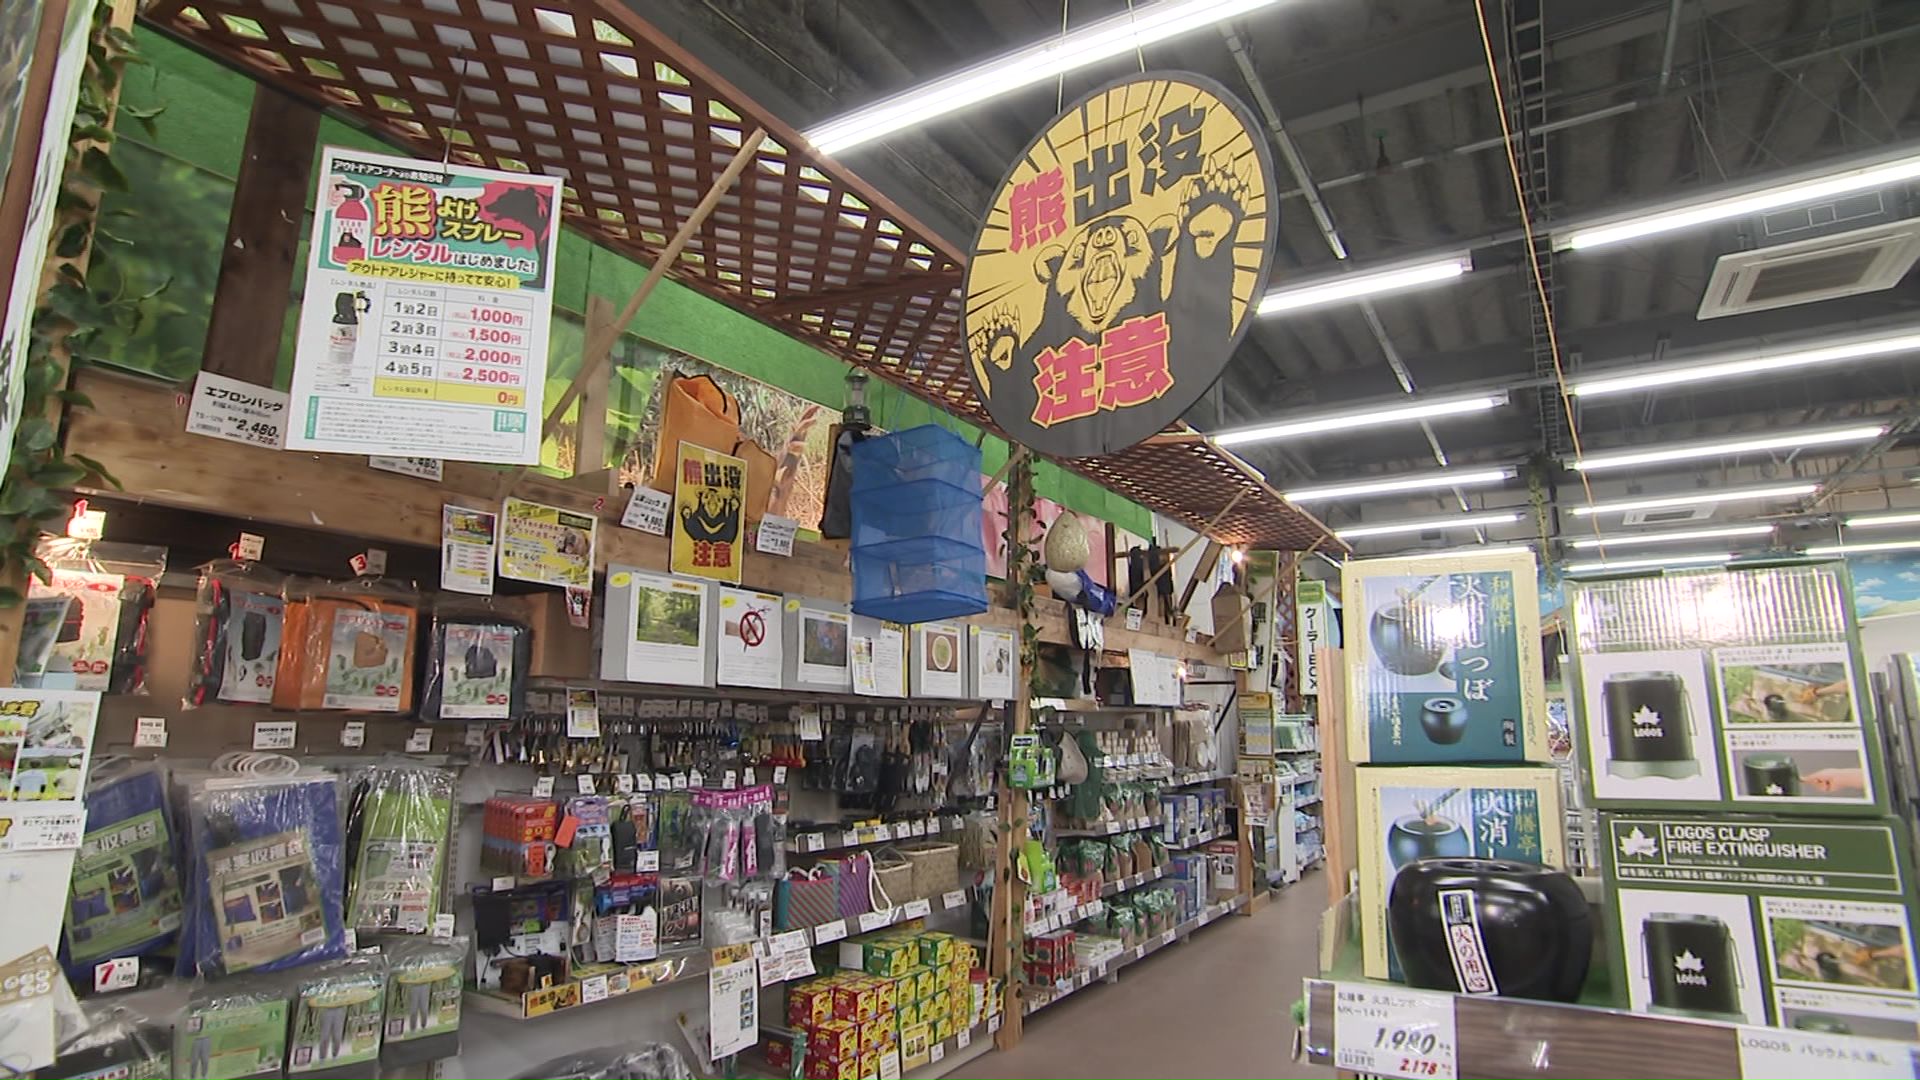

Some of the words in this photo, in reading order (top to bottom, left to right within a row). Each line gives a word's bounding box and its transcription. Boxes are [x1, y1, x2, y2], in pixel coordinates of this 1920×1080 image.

[1009, 103, 1207, 253] 熊出没
[441, 221, 524, 243] スプレー
[393, 302, 438, 316] 1泊2日
[470, 308, 524, 326] 1,000円
[389, 321, 437, 336] 2泊3日
[468, 328, 521, 344] 1,500円
[388, 341, 435, 356] 3泊4日
[464, 348, 521, 365] 2,000円
[385, 361, 433, 376] 4泊5日
[462, 368, 520, 385] 2,500円
[1031, 312, 1174, 428] 注意
[497, 391, 518, 406] 0円
[683, 459, 742, 490] 熊出没
[692, 541, 732, 568] 注意
[356, 555, 367, 572] 3
[1633, 727, 1664, 738] LOGOS
[1664, 825, 1716, 840] LOGOS
[1718, 827, 1770, 842] CLASP
[1666, 840, 1702, 855] FIRE
[1706, 842, 1827, 860] EXTINGUISHER
[1455, 927, 1485, 988] 火の用心
[100, 964, 114, 985] 7
[1675, 973, 1708, 987] LOGOS
[1740, 1039, 1792, 1053] LOGOS
